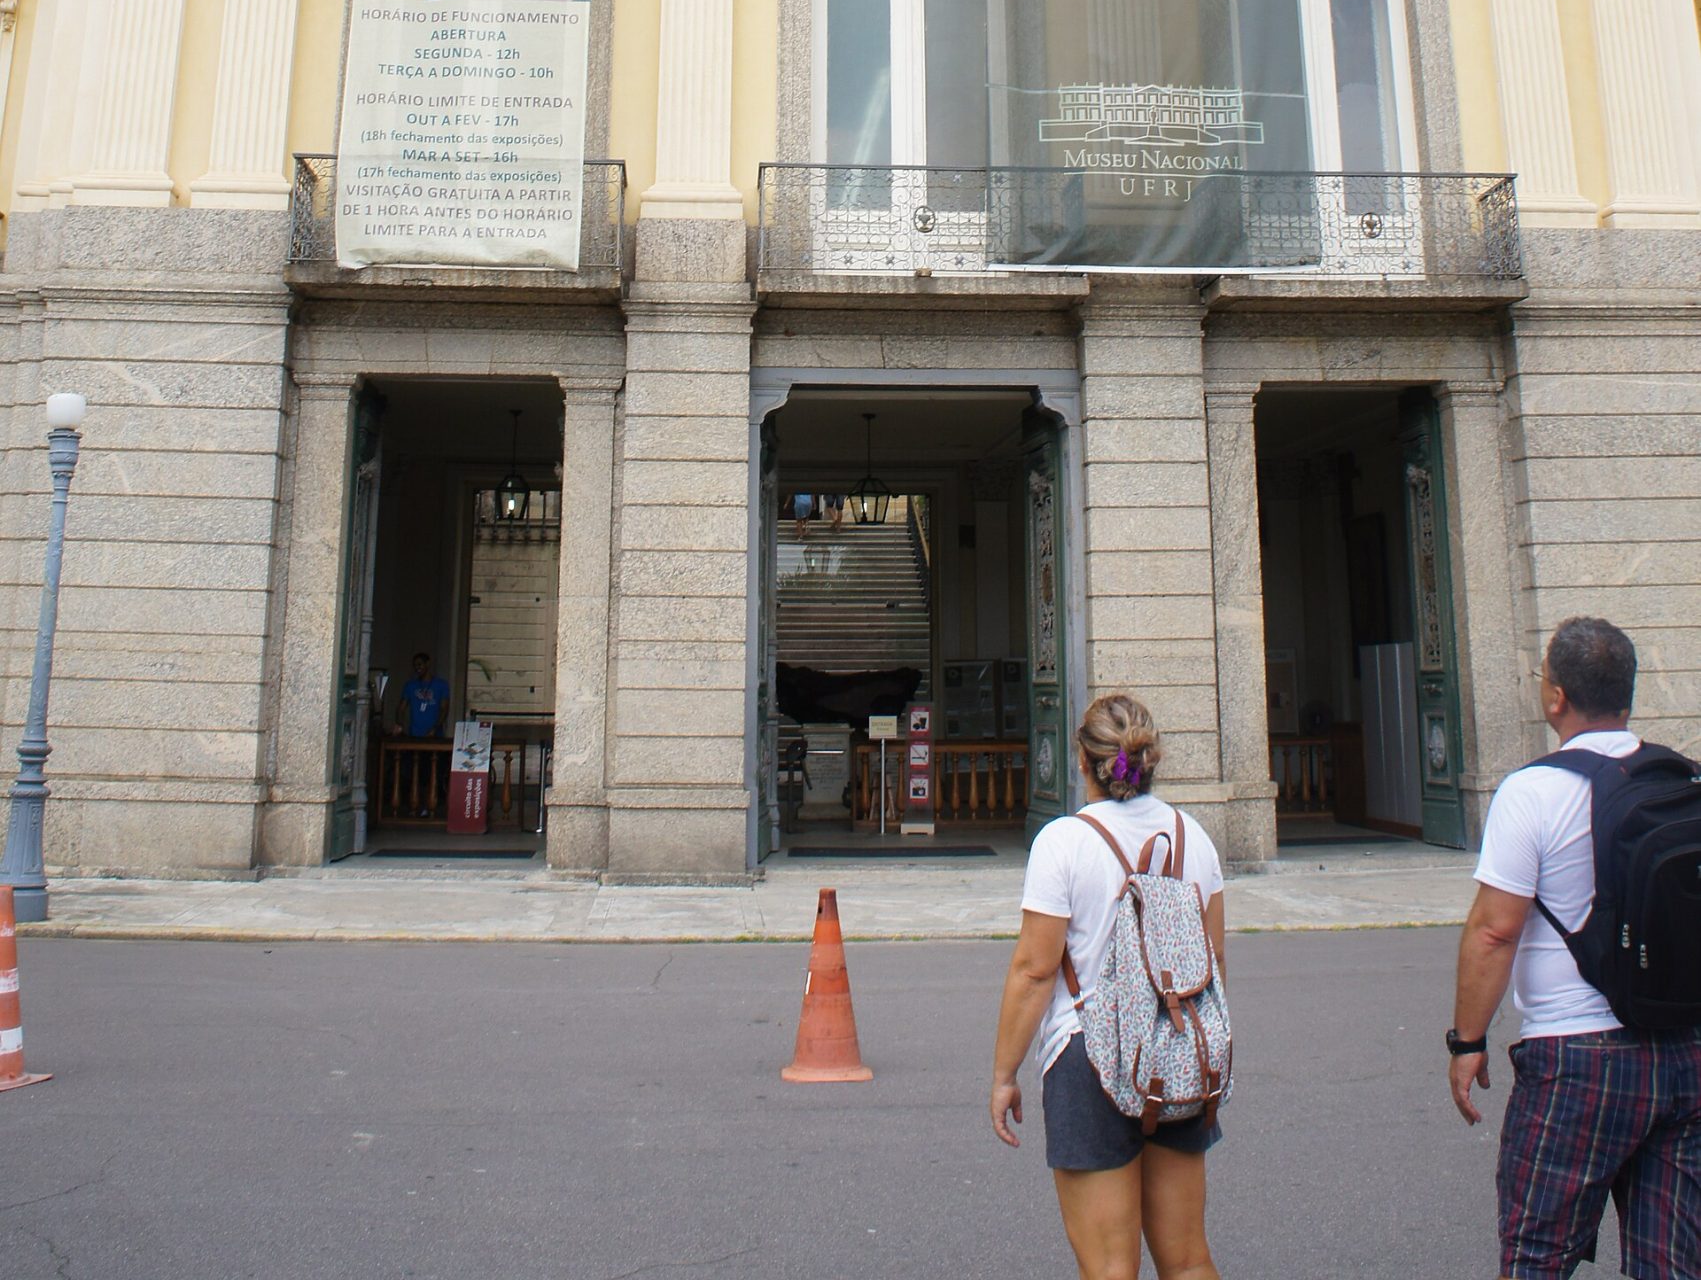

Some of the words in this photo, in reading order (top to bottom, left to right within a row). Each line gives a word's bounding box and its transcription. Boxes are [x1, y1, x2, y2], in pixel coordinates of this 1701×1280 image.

[361, 8, 427, 23] HORÁRIO
[431, 11, 448, 23] DE
[452, 10, 579, 25] FUNCIONAMENTO
[430, 29, 507, 42] ABERTURA
[414, 47, 483, 60] SEGUNDA
[496, 48, 520, 60] 12h
[378, 64, 424, 79] TERÇA
[428, 67, 438, 78] A
[442, 66, 516, 79] DOMINGO
[529, 67, 554, 79] 10h
[356, 91, 424, 107] HORÁRIO
[428, 95, 476, 108] LIMITE
[481, 96, 500, 108] DE
[504, 96, 574, 109] ENTRADA
[406, 113, 438, 126] OUT
[441, 115, 451, 126] A
[455, 114, 481, 126] FEV
[494, 115, 519, 127] 17h
[361, 130, 387, 144] (18h
[391, 130, 464, 144] fechamento
[467, 133, 488, 144] das
[492, 133, 564, 147] exposições)
[402, 149, 437, 162] MAR
[441, 151, 451, 163] A
[455, 151, 480, 163] SET
[493, 151, 519, 163] 16h
[358, 167, 384, 179] (17h
[388, 167, 461, 181] fechamento
[465, 170, 486, 181] das
[490, 170, 562, 184] exposições)
[346, 183, 423, 199] VISITAÇÃO
[428, 187, 501, 200] GRATUITA
[505, 189, 515, 201] A
[519, 189, 572, 201] PARTIR
[1120, 177, 1193, 202] UFRJ
[343, 204, 361, 216] DE
[365, 204, 373, 216] 1
[377, 204, 419, 217] HORA
[424, 206, 472, 219] ANTES
[477, 208, 499, 220] DO
[503, 206, 573, 221] HORÁRIO
[364, 223, 414, 236] LIMITE
[419, 224, 457, 237] PARA
[463, 227, 472, 238] A
[477, 227, 547, 239] ENTRADA
